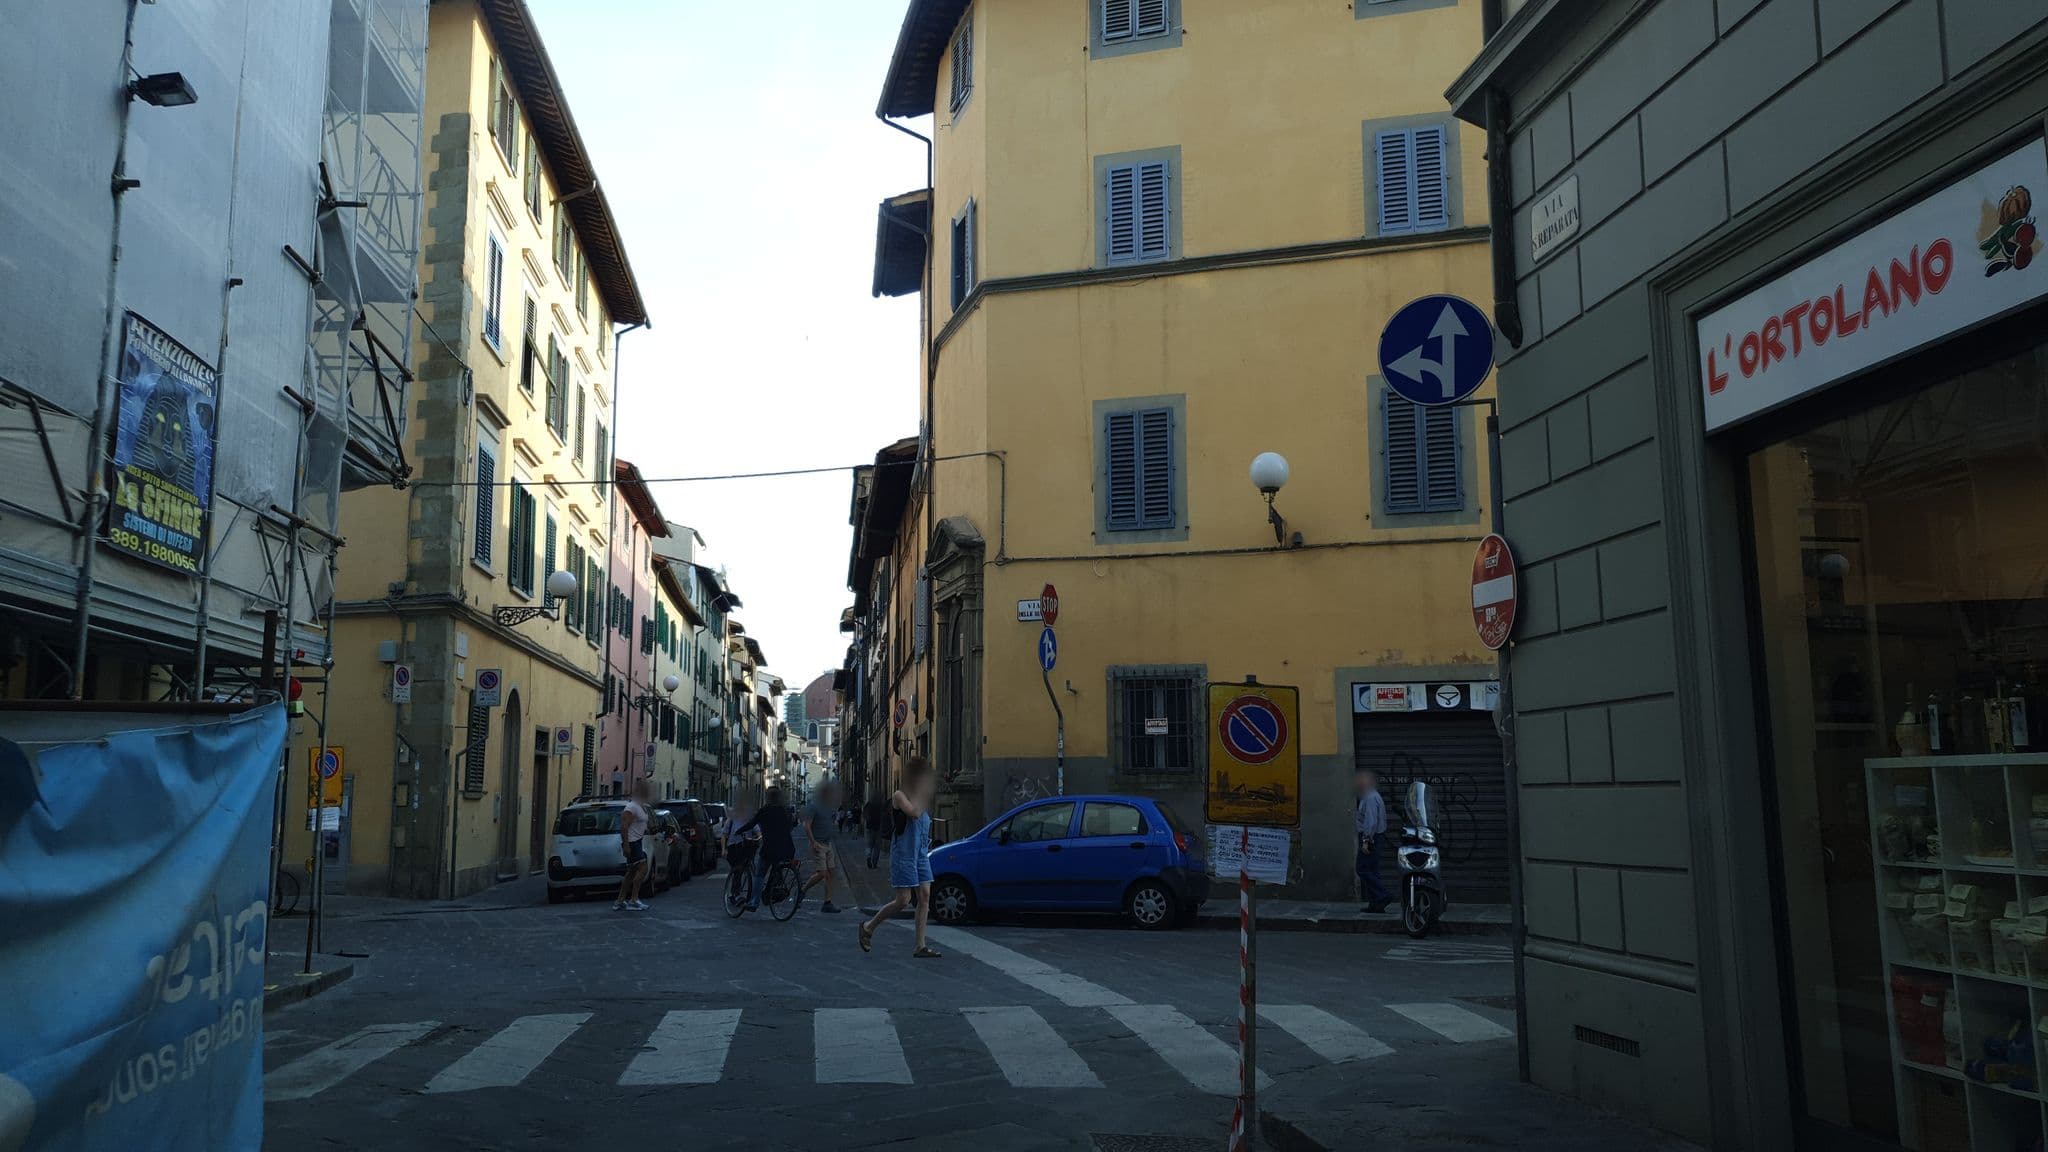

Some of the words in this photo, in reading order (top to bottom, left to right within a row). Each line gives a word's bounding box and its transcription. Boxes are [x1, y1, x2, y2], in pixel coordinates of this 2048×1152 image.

[1544, 194, 1563, 218] VIA
[1707, 238, 1953, 396] L'ORTOLANO
[142, 483, 203, 539] SFINGE
[110, 527, 197, 572] 389.1980055
[1042, 596, 1058, 614] STOP
